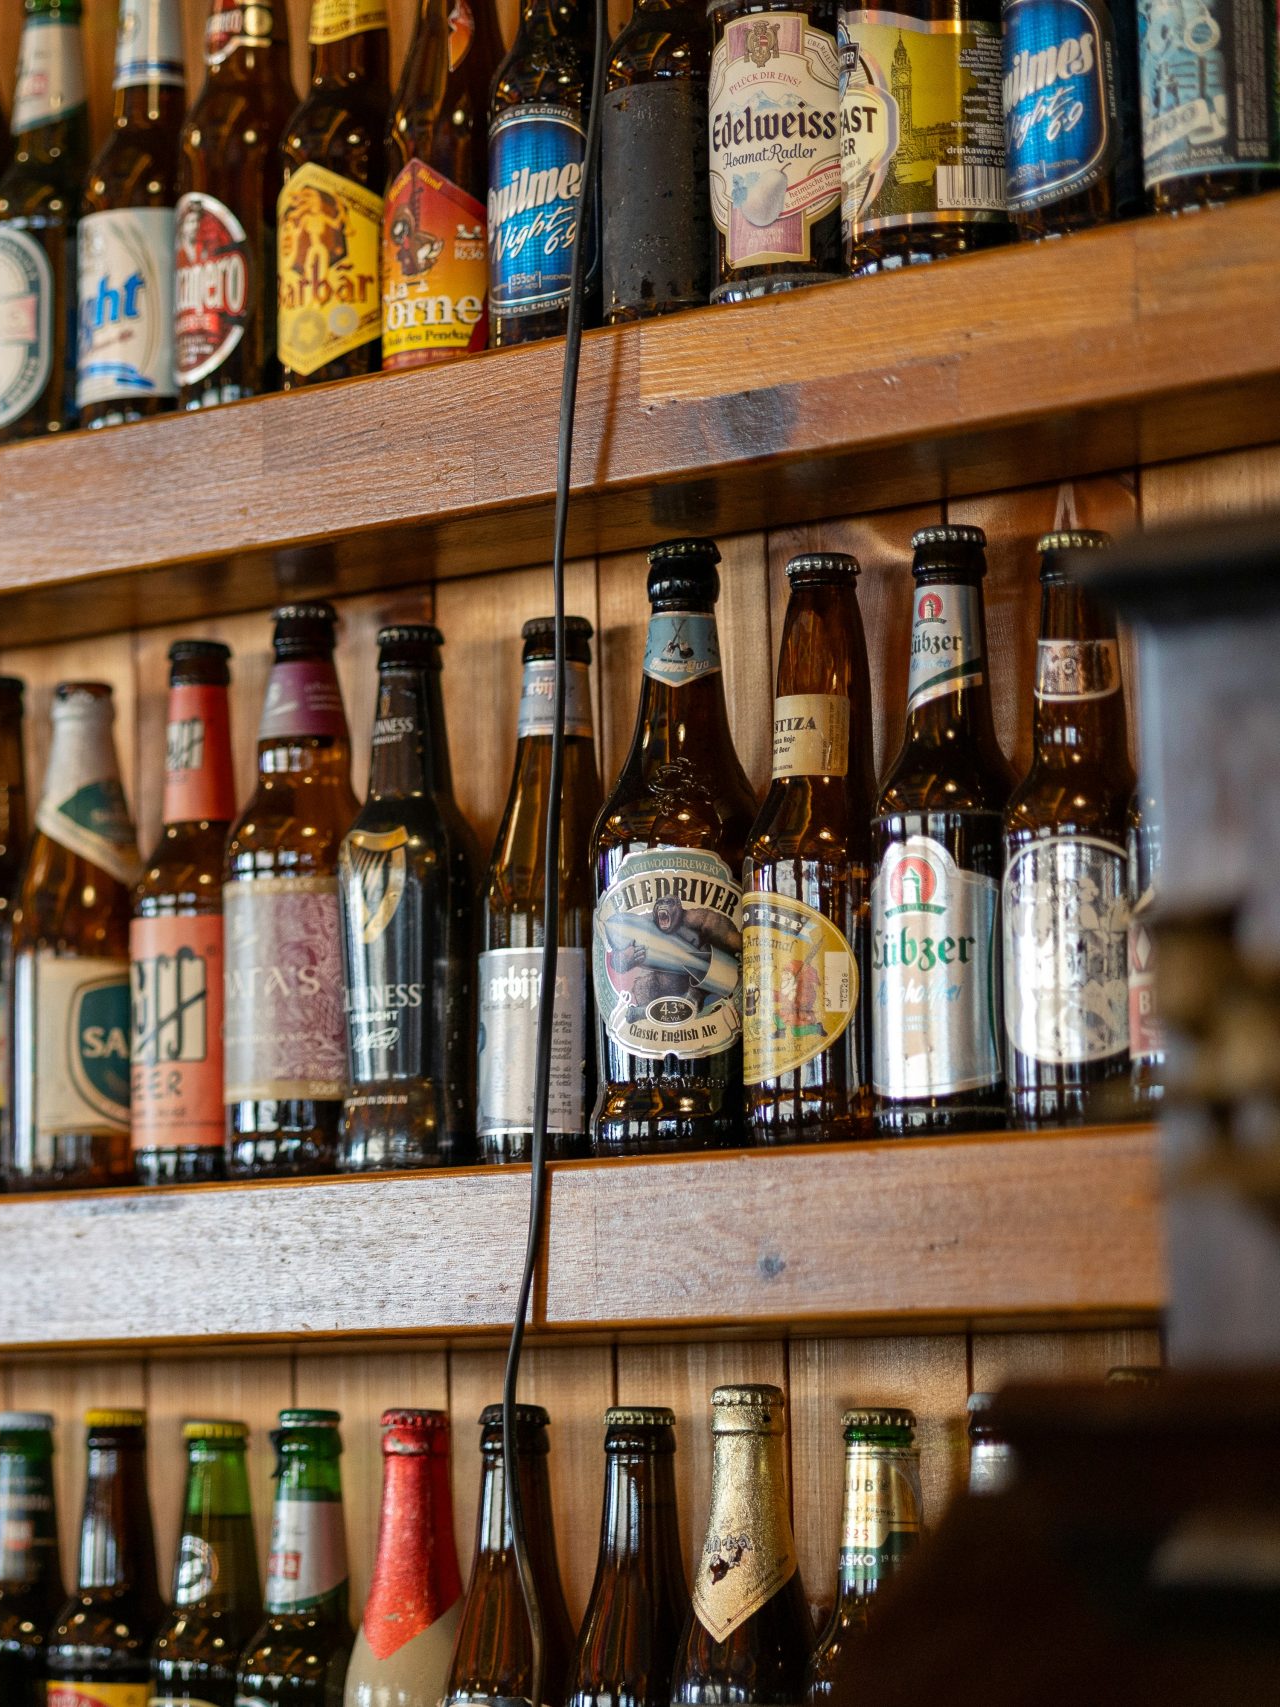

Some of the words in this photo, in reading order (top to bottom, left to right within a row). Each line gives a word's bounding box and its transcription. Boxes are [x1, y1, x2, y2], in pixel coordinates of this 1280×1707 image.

[760, 71, 776, 80] DIR
[777, 72, 802, 88] EINS!
[528, 107, 575, 120] ALCOHOL
[712, 101, 838, 152] Edelweiss
[723, 147, 770, 170] Hoamat
[768, 143, 818, 164] Radler
[963, 155, 984, 164] 500ml
[788, 177, 824, 199] heimische
[790, 184, 826, 206] erfrischende
[487, 162, 585, 246] Quilme
[675, 857, 721, 877] BREWERY
[873, 925, 977, 972] Lübzer
[629, 1023, 659, 1042] Classic
[661, 1028, 700, 1044] English
[702, 1023, 719, 1036] Ale
